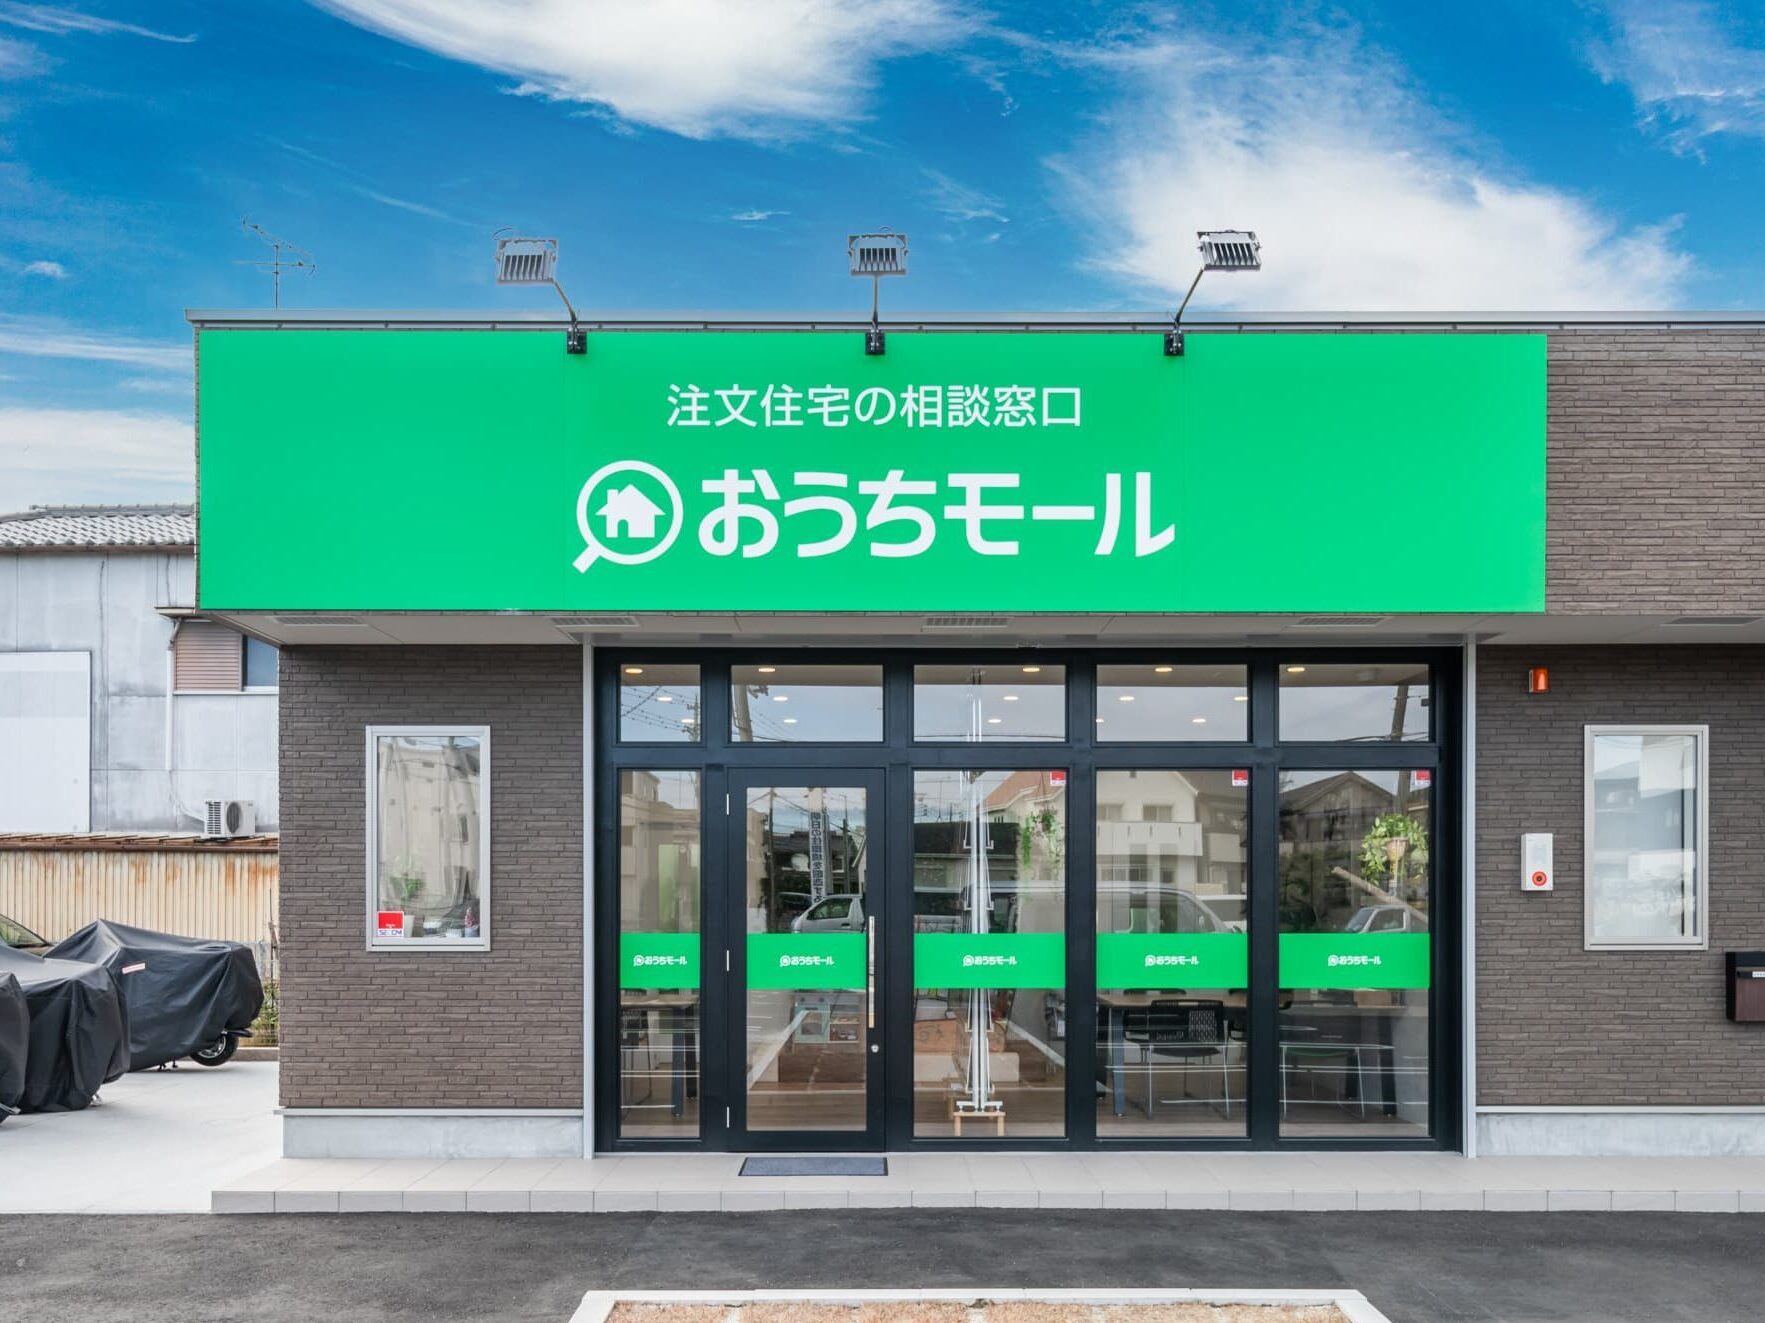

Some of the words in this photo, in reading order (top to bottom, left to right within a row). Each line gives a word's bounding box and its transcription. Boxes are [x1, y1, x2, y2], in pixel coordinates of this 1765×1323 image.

[667, 383, 1081, 428] 注文住宅の相談窓口
[698, 468, 1176, 559] おうちモール
[644, 956, 687, 966] おうちモール
[791, 956, 834, 966] おうちモール
[974, 956, 1017, 966] おうちモール
[1156, 956, 1199, 966] おうちモール
[1339, 956, 1382, 966] おうちモール
